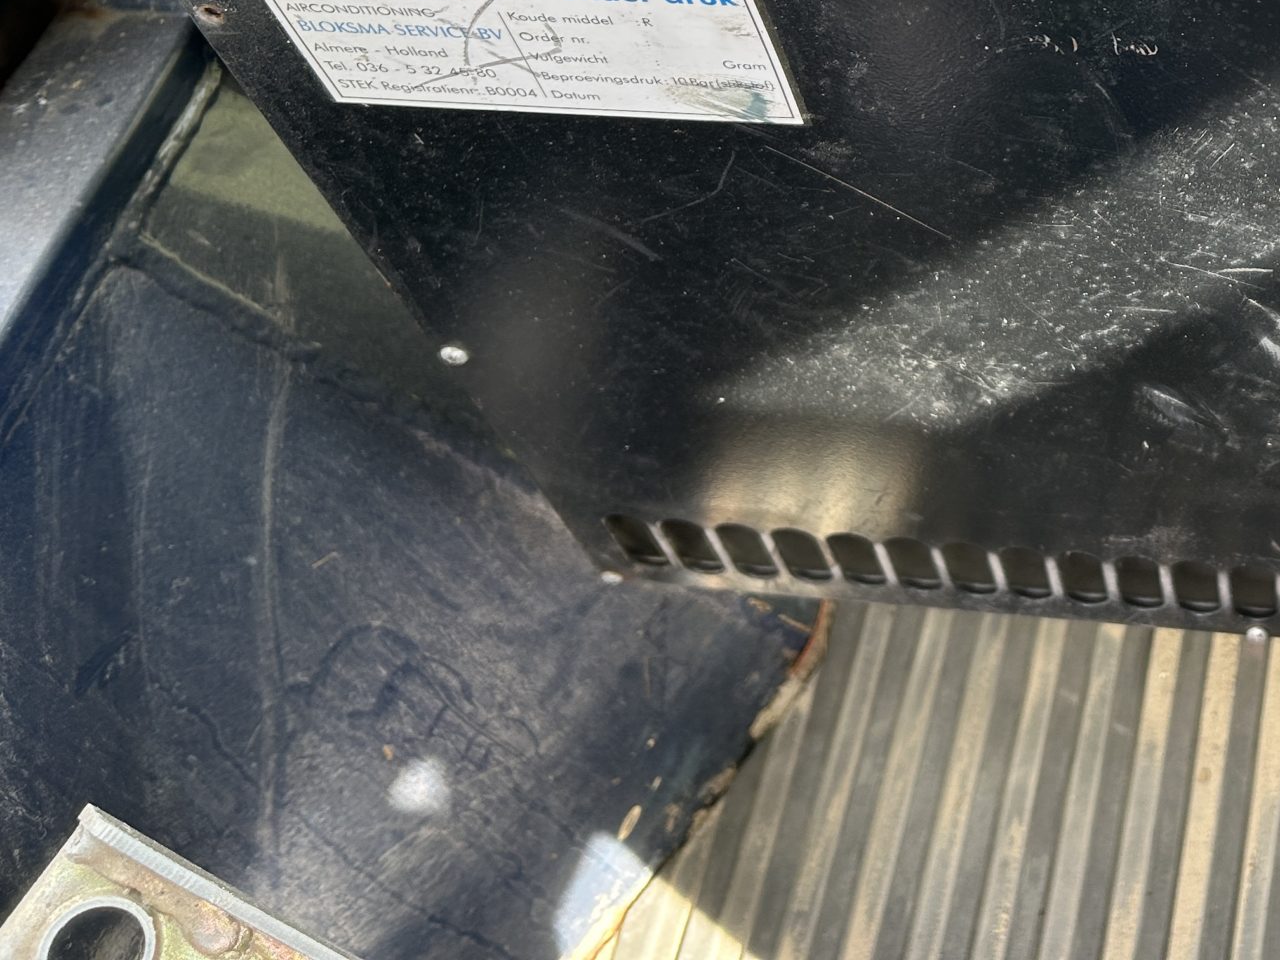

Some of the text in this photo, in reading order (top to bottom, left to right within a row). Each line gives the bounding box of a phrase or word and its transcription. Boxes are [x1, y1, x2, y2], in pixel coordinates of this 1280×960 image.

[286, 2, 437, 18] AIRCONDITIONING
[507, 11, 557, 24] Koude
[561, 13, 614, 27] middel
[298, 19, 503, 41] BLOKSMA SERVICE BV
[518, 31, 565, 43] Order
[570, 34, 591, 46] nr.
[313, 42, 369, 55] Almere
[387, 46, 449, 59] Holland
[324, 60, 352, 72] Tel.
[355, 62, 389, 73] 036
[420, 66, 442, 76] 32
[528, 51, 609, 65] Vulgewicht
[722, 59, 768, 71] Gram
[337, 78, 379, 91] STEK
[551, 89, 601, 101] Datum
